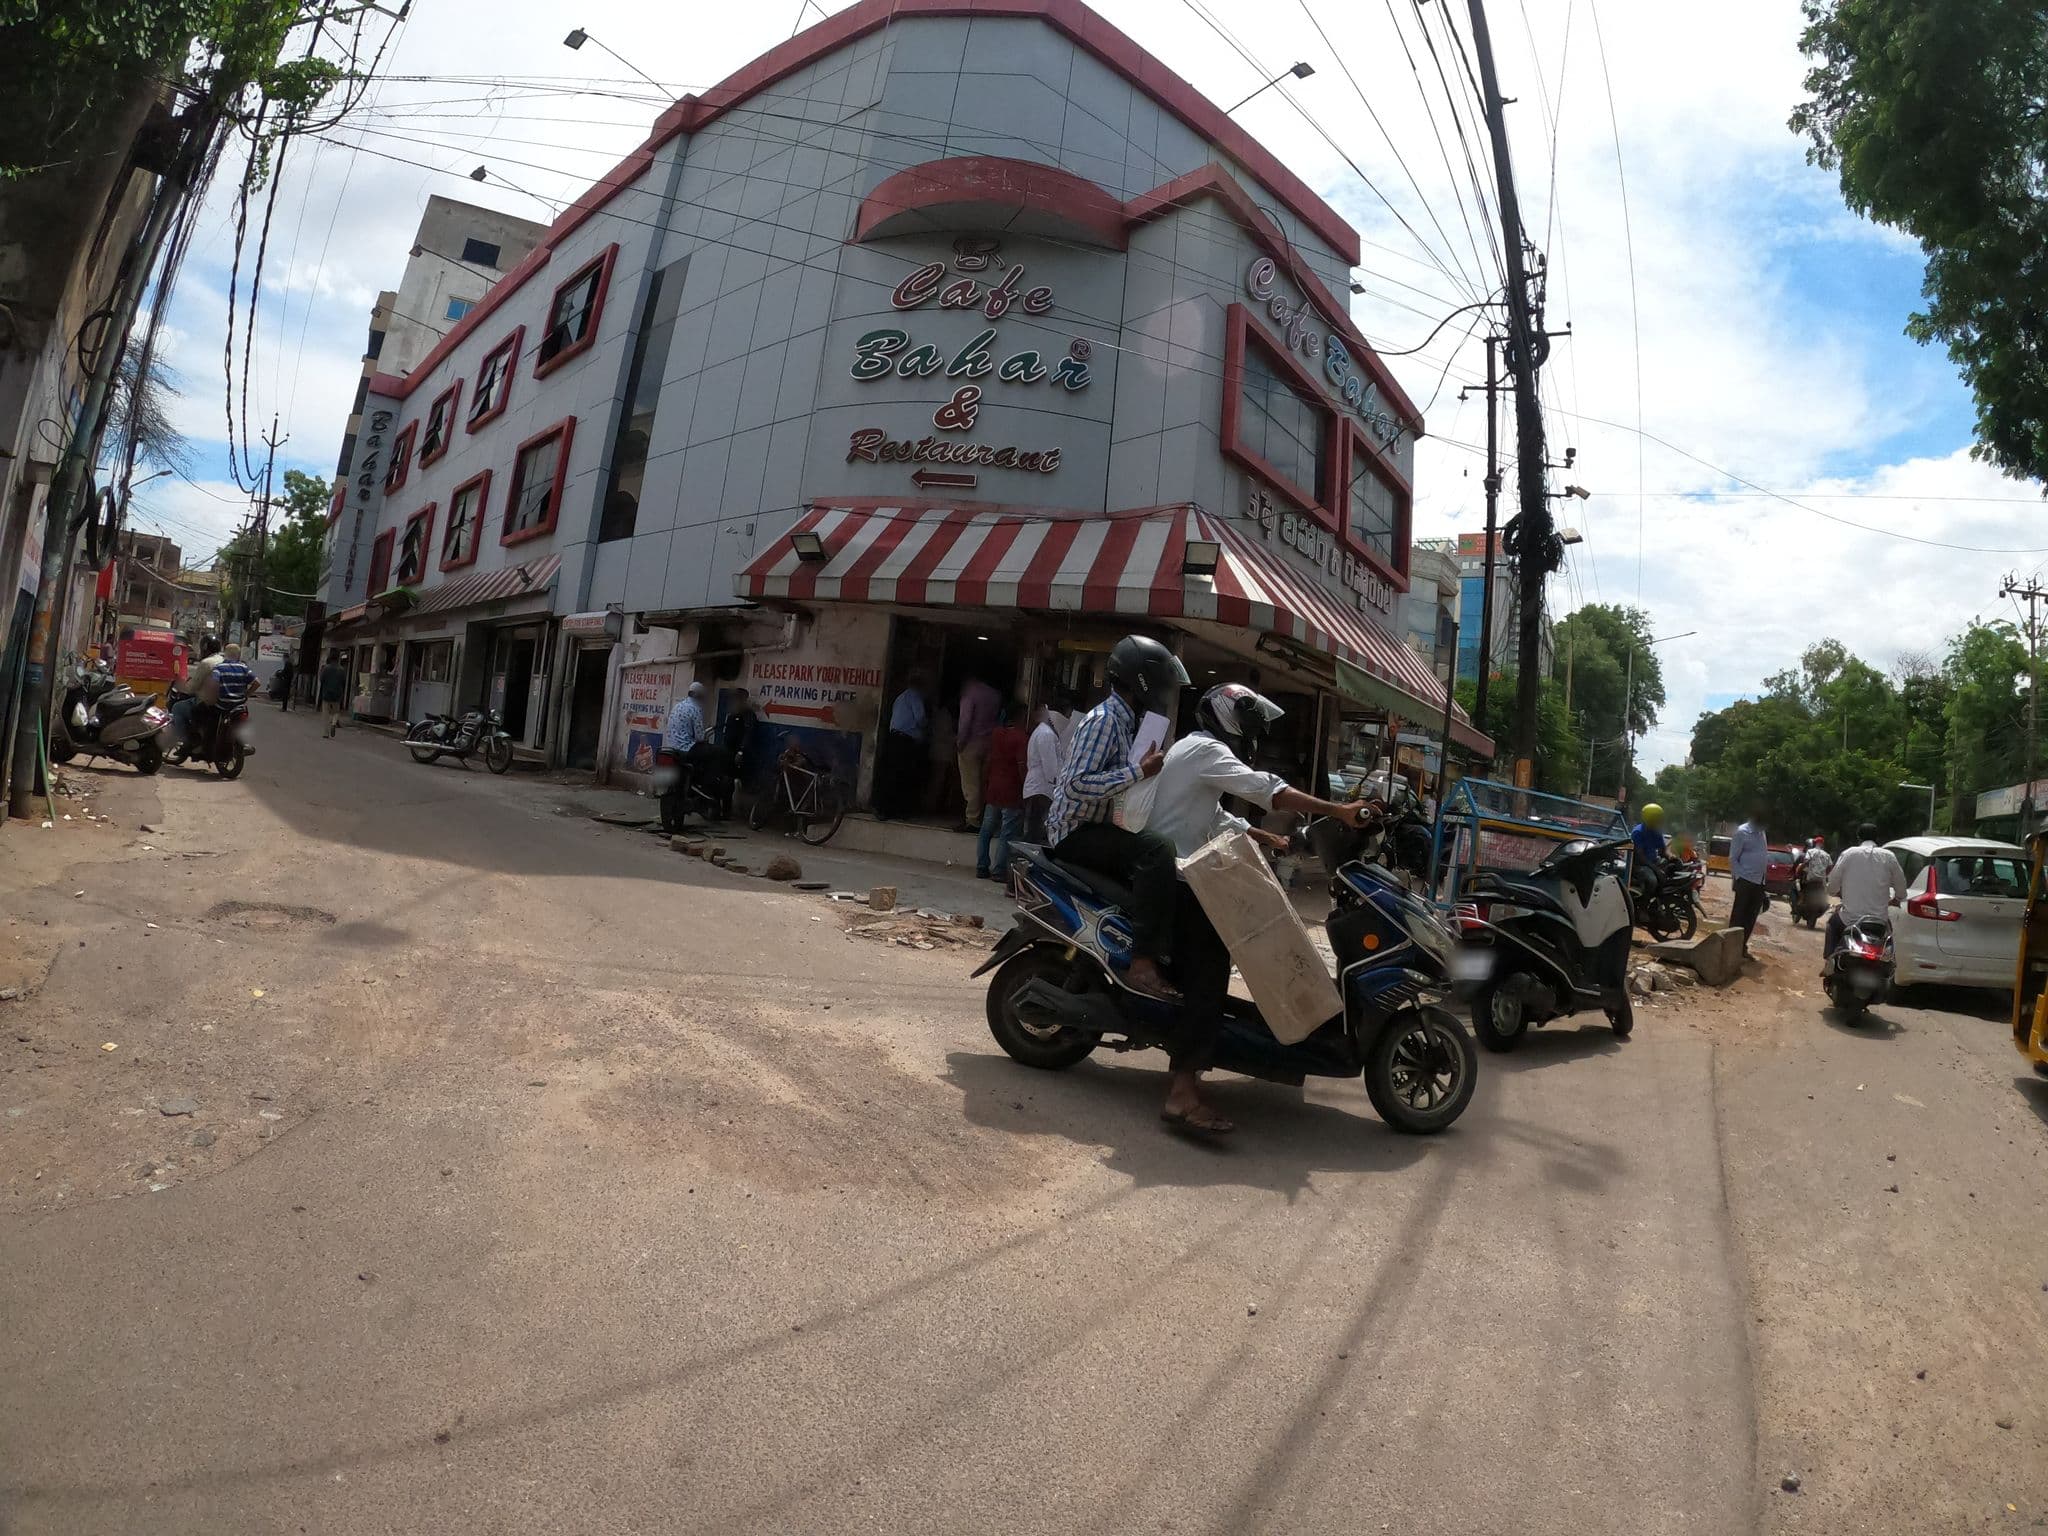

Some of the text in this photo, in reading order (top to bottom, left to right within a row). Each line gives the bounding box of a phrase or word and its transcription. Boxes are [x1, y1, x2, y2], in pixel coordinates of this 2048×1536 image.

[890, 262, 1055, 319] Cafe
[850, 328, 1092, 390] Bahar
[1246, 257, 1403, 455] Cafe Bahar
[932, 384, 982, 430] &
[846, 428, 1062, 473] Restaurant
[752, 663, 882, 688] PLEASE PARK YOUR VEHICLE
[760, 685, 857, 704] AT PARKING PLACE
